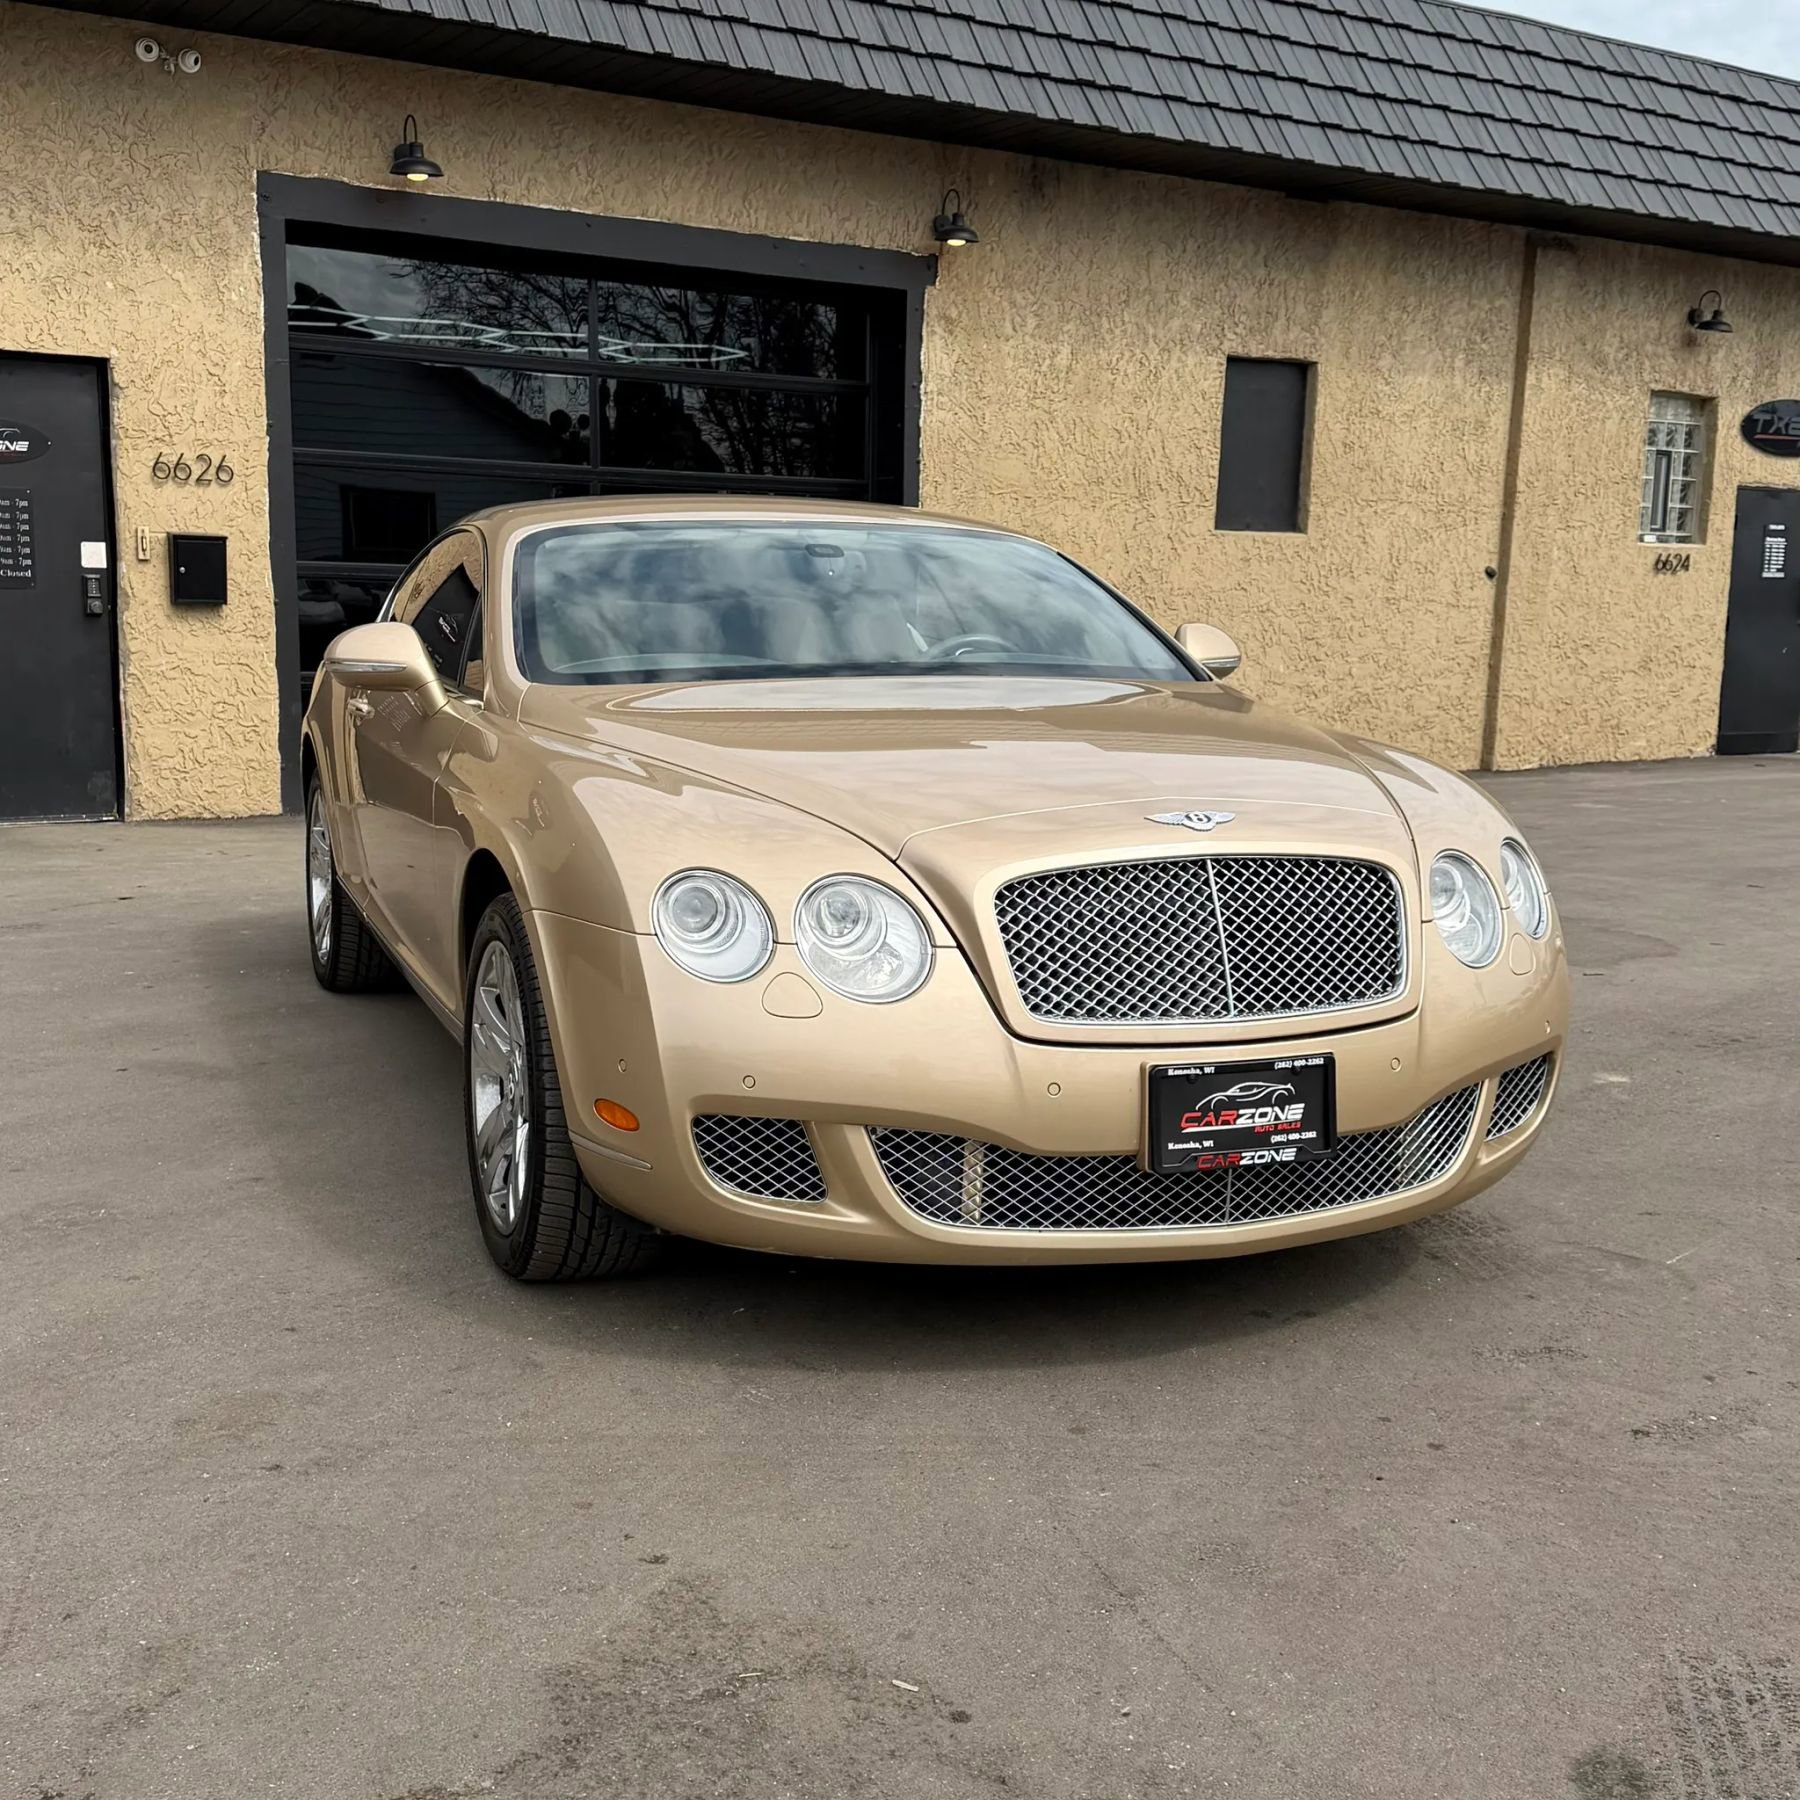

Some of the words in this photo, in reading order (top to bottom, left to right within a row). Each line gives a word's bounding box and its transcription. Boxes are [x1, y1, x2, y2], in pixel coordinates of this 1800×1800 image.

[0, 440, 29, 452] NE
[152, 451, 234, 483] 6626
[1655, 553, 1691, 575] 6624
[0, 569, 31, 577] Closed
[1204, 1066, 1215, 1074] WI
[1180, 1103, 1305, 1128] CARZONE
[1254, 1124, 1274, 1133] AUTO
[1277, 1120, 1302, 1131] SALES
[1168, 1140, 1202, 1150] Kenosha,
[1197, 1148, 1297, 1169] CARZONE
